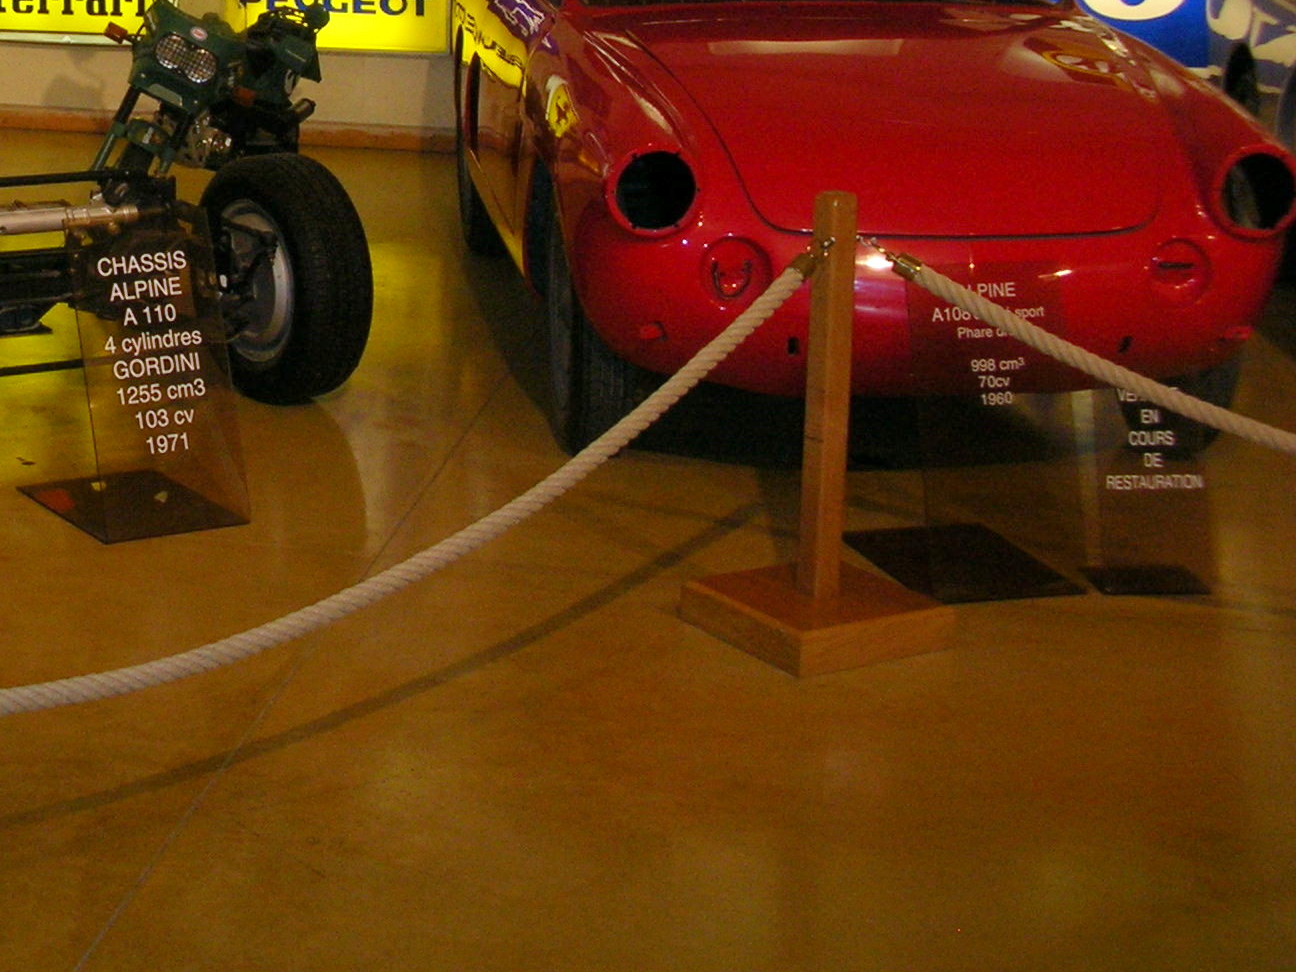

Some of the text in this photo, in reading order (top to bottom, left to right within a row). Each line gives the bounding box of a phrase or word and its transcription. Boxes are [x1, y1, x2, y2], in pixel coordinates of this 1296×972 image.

[97, 250, 187, 277] CHASSIS
[109, 277, 183, 302] ALPINE
[123, 303, 177, 327] A 110
[104, 328, 203, 356] 4 cylindres
[957, 327, 994, 339] Phare
[113, 352, 201, 380] GORDINI
[970, 358, 997, 372] 998
[977, 374, 1011, 388] 70cv
[116, 378, 206, 406] 1255 cm3
[980, 391, 1014, 405] 1960
[135, 408, 195, 430] 103 cv
[1140, 408, 1159, 424] EN
[145, 432, 190, 455] 1971
[1128, 430, 1175, 446] COURS
[1144, 452, 1163, 467] DE
[1105, 474, 1204, 490] RESTAURATION
